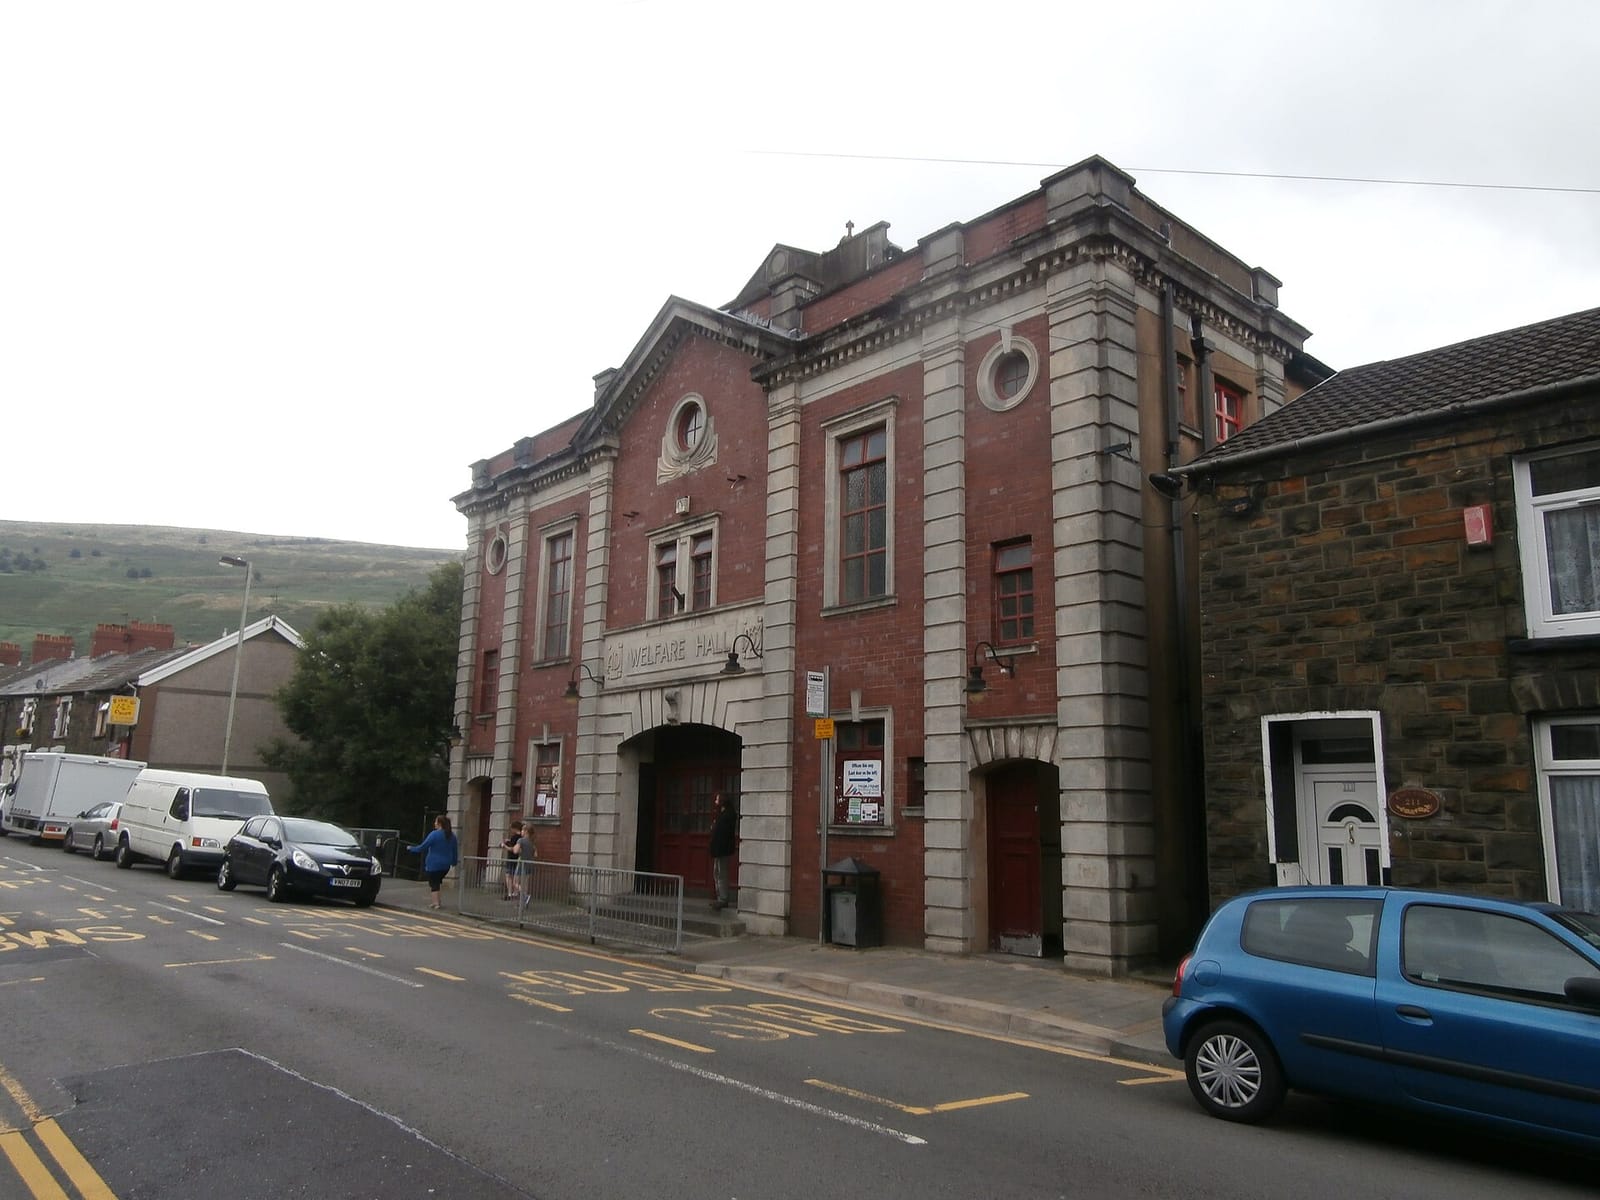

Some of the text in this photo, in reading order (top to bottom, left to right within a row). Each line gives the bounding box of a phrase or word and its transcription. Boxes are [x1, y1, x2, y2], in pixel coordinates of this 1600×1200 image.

[629, 641, 685, 668] WELFARE
[696, 632, 731, 657] HALL
[498, 970, 731, 995] STOP
[648, 1003, 905, 1041] BUS
